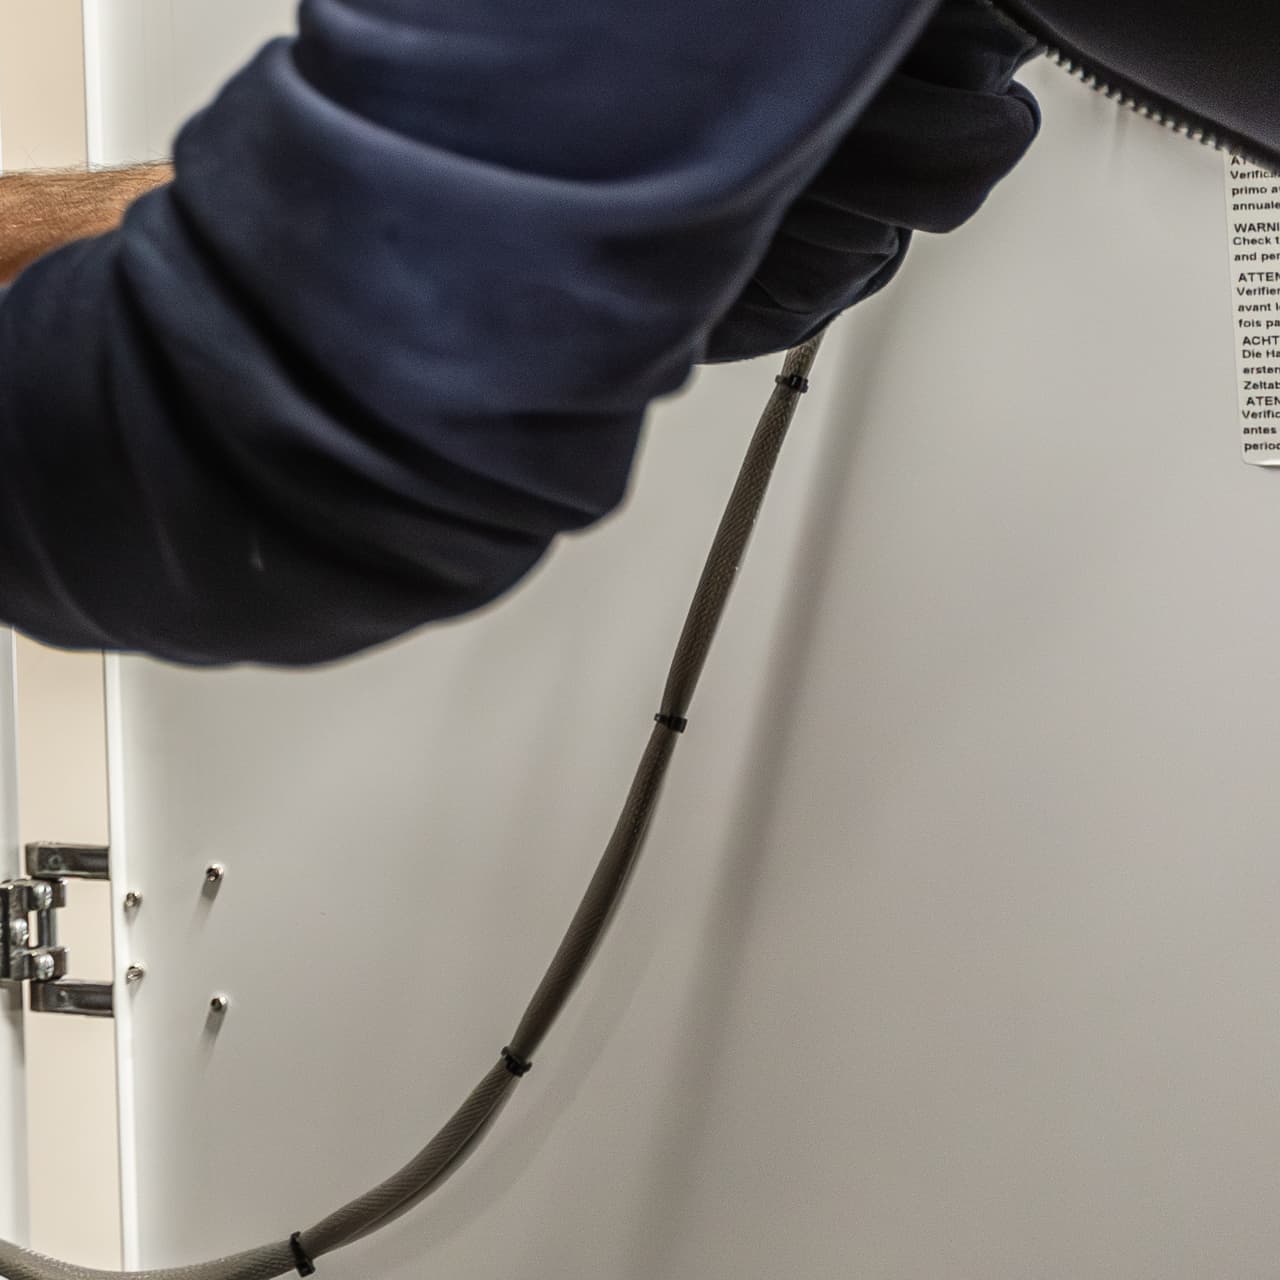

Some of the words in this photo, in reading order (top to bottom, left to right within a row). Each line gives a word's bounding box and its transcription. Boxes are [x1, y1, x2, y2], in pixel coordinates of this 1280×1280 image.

[1231, 186, 1268, 198] primo
[1233, 236, 1271, 245] Check
[1234, 252, 1257, 261] and
[1238, 303, 1272, 312] avant
[1239, 319, 1261, 328] fois
[1242, 350, 1262, 359] Die
[1243, 426, 1277, 435] antes
